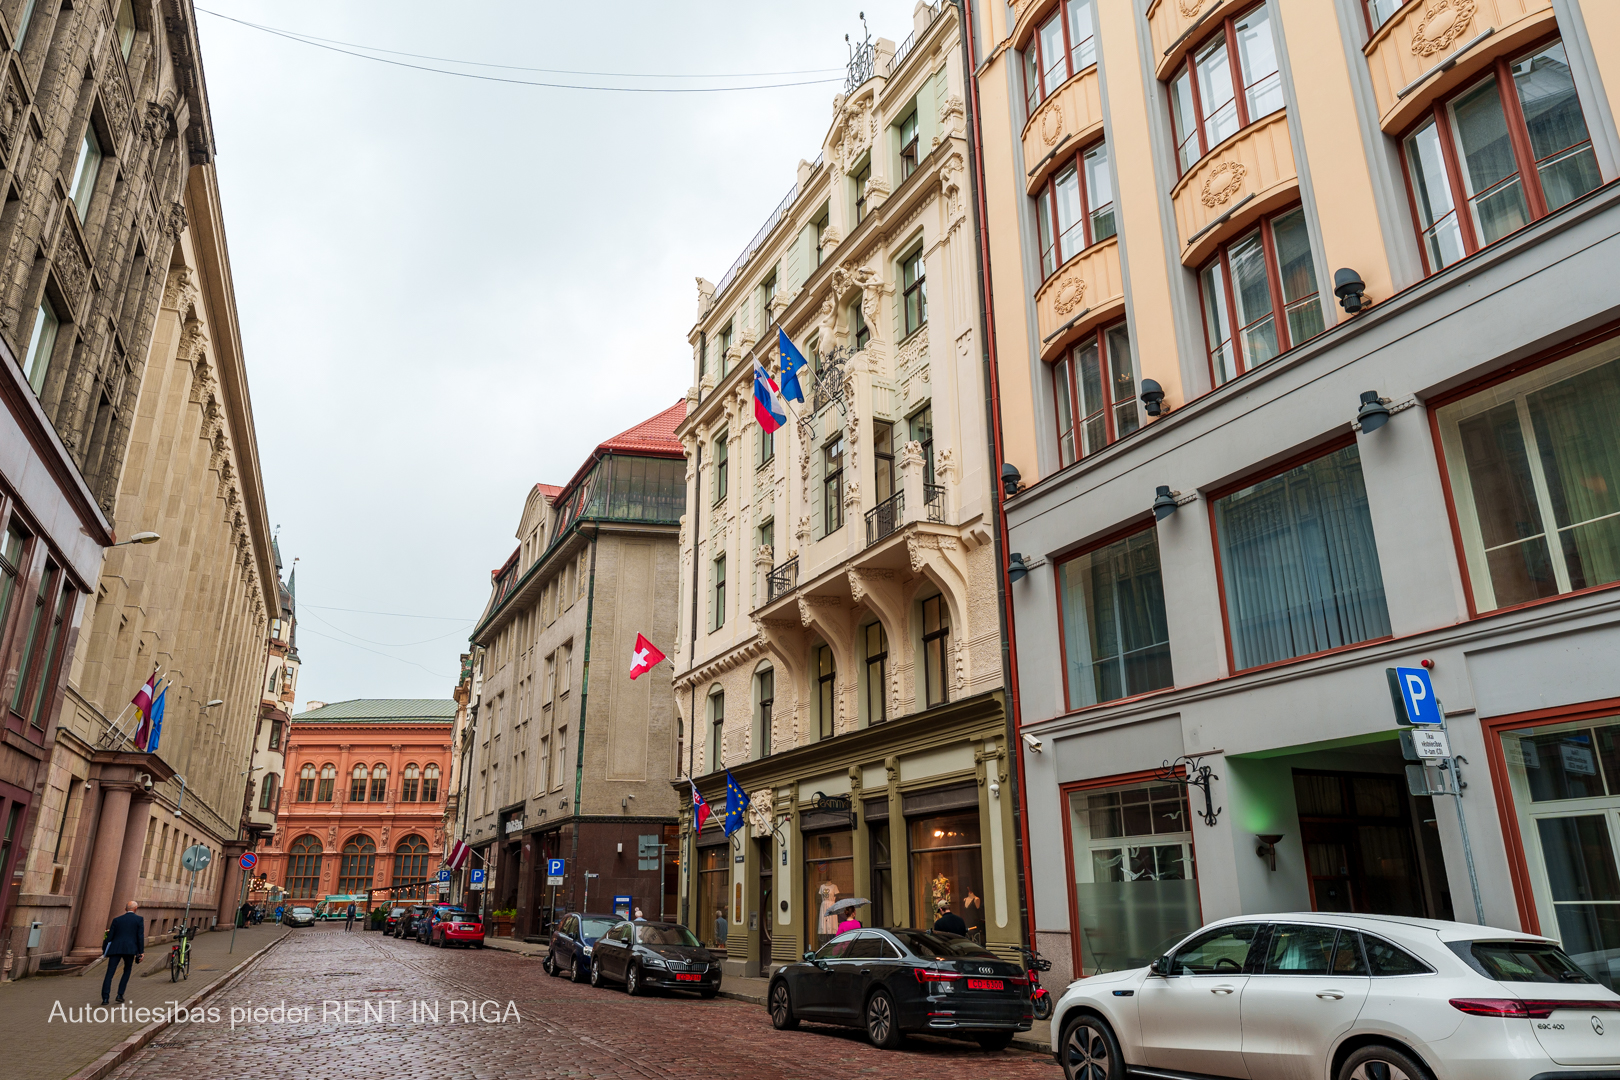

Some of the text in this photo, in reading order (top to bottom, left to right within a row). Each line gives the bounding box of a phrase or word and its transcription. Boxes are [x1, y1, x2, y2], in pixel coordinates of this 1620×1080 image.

[1405, 674, 1427, 716] P
[1424, 732, 1435, 740] Tikai
[551, 860, 561, 874] P
[441, 871, 449, 880] P
[473, 870, 482, 881] P
